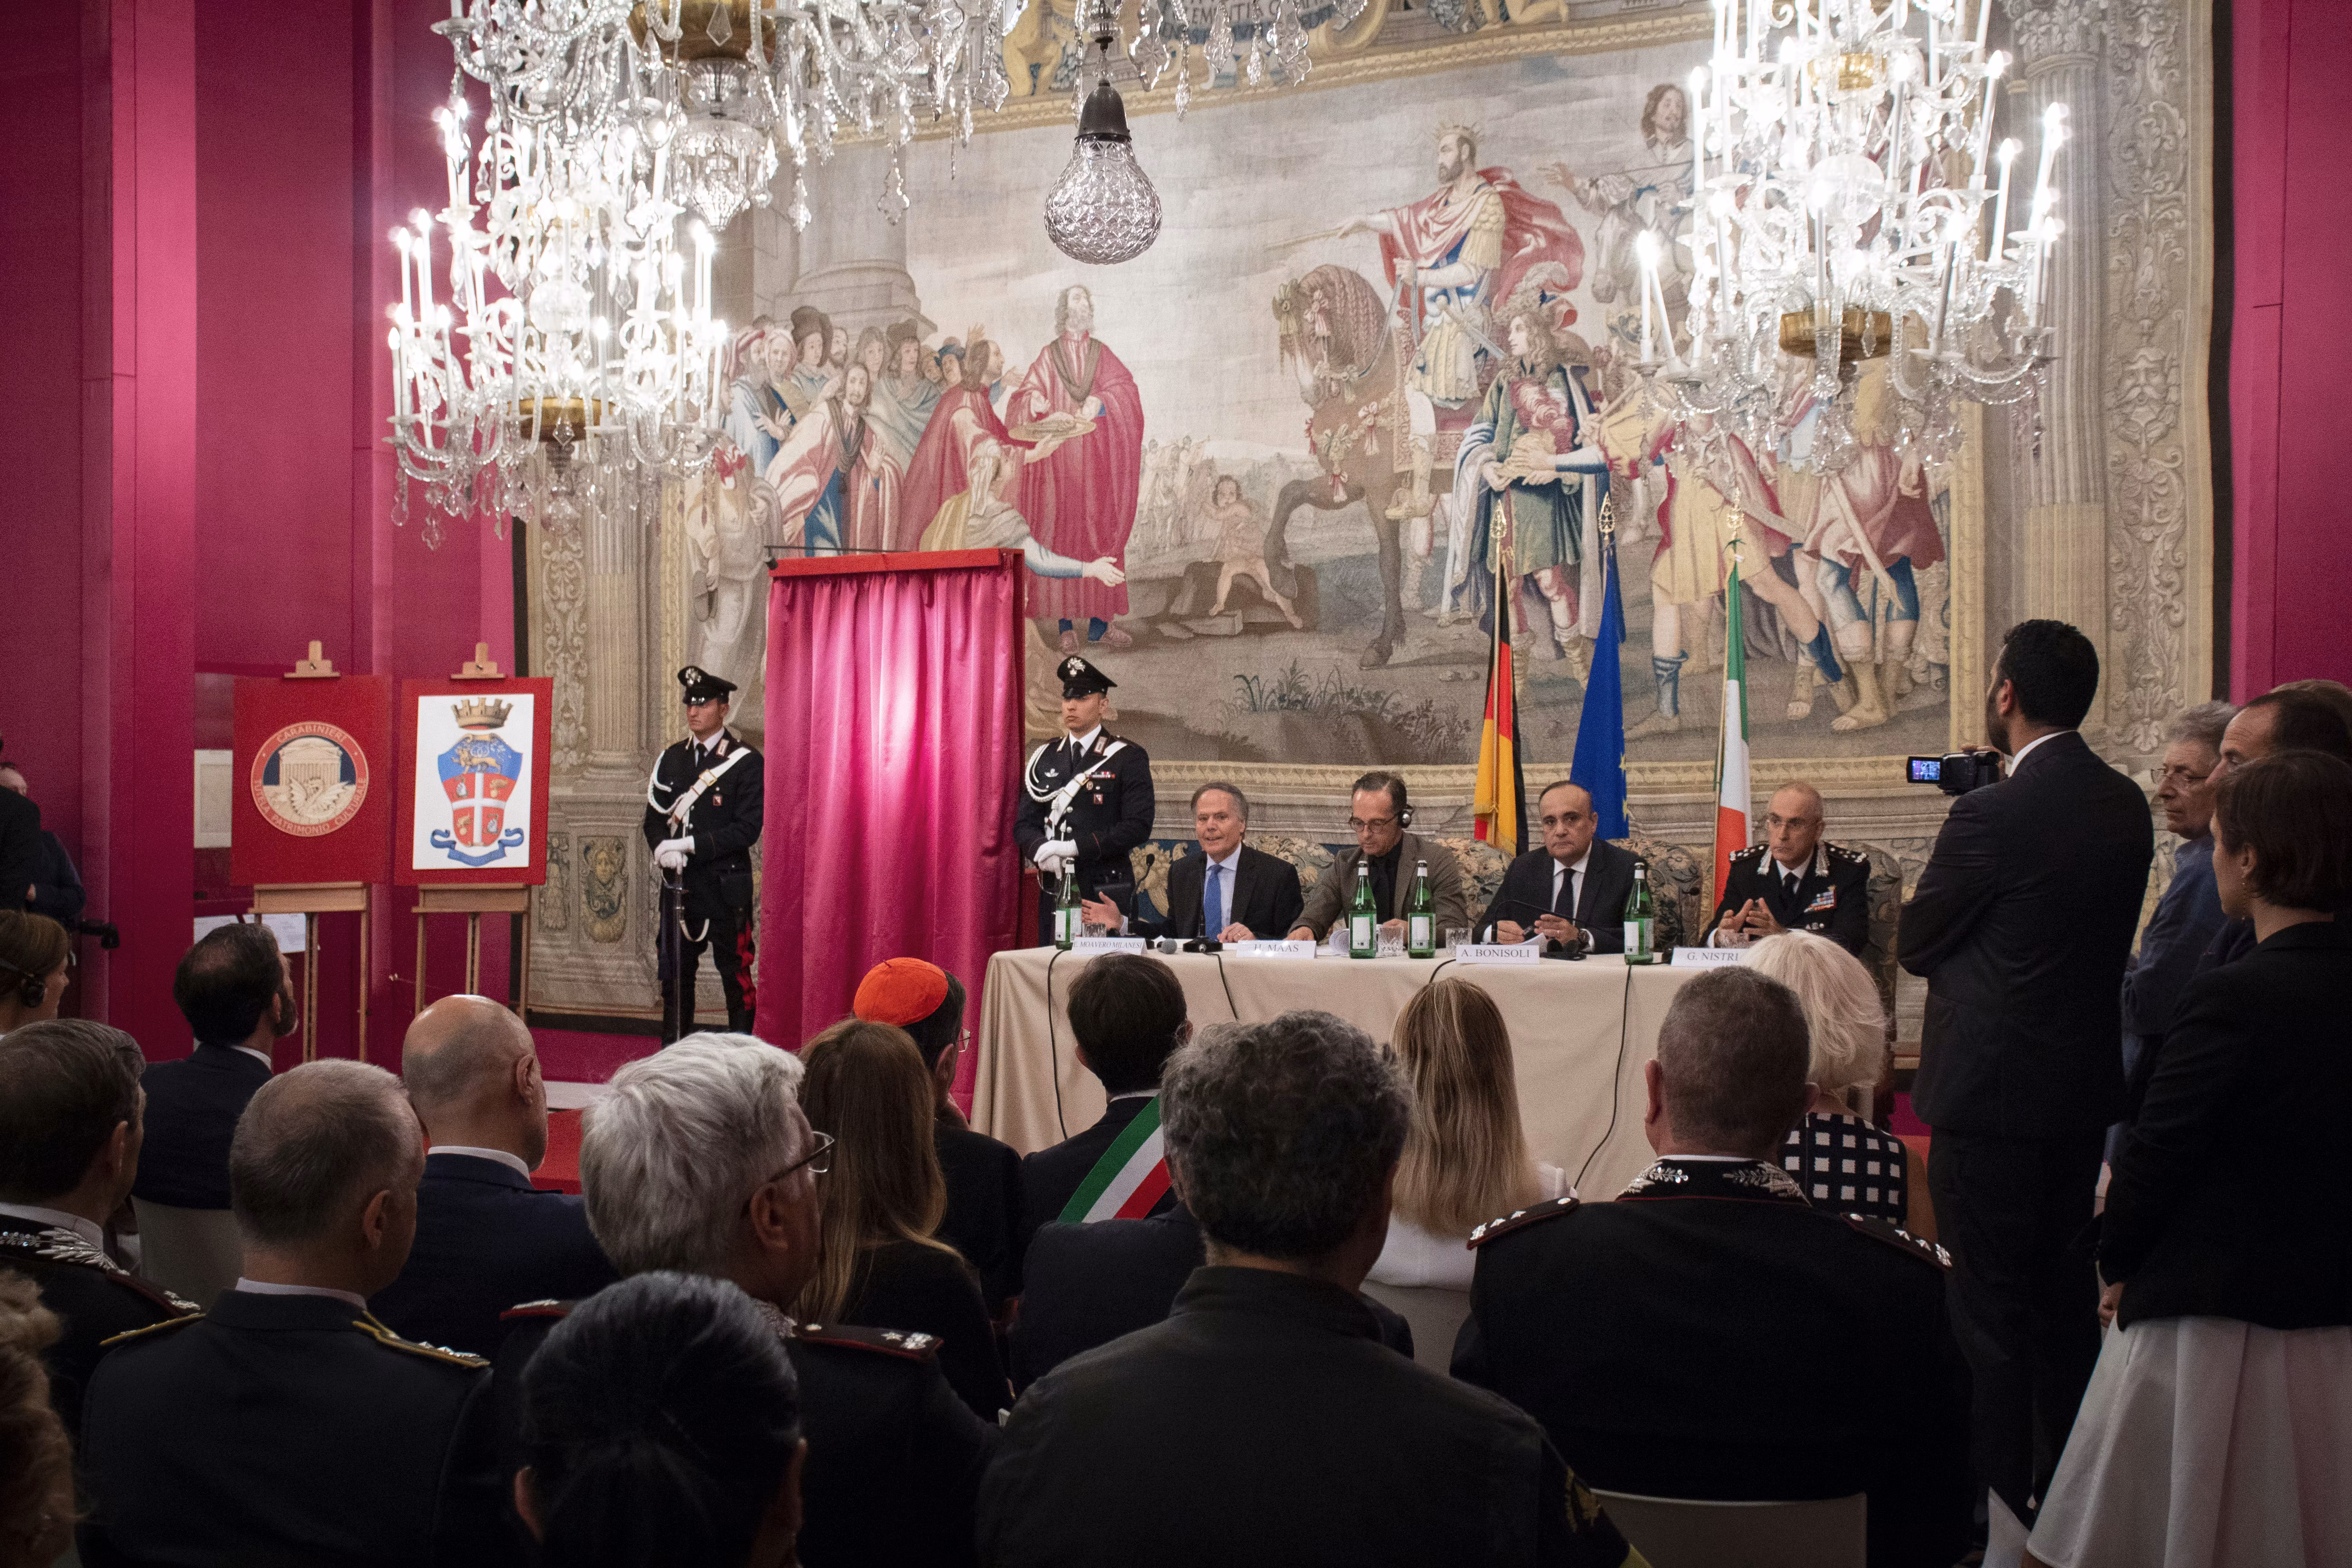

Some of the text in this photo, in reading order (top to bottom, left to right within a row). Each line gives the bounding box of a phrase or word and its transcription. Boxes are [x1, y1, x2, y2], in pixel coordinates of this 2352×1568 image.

[277, 725, 347, 743] CARABINIERI
[254, 779, 367, 835] TUTELA PATRIMONIO CULTURALE
[1475, 949, 1529, 957] BONISOLI
[1687, 952, 1739, 961] G. NISTRI
